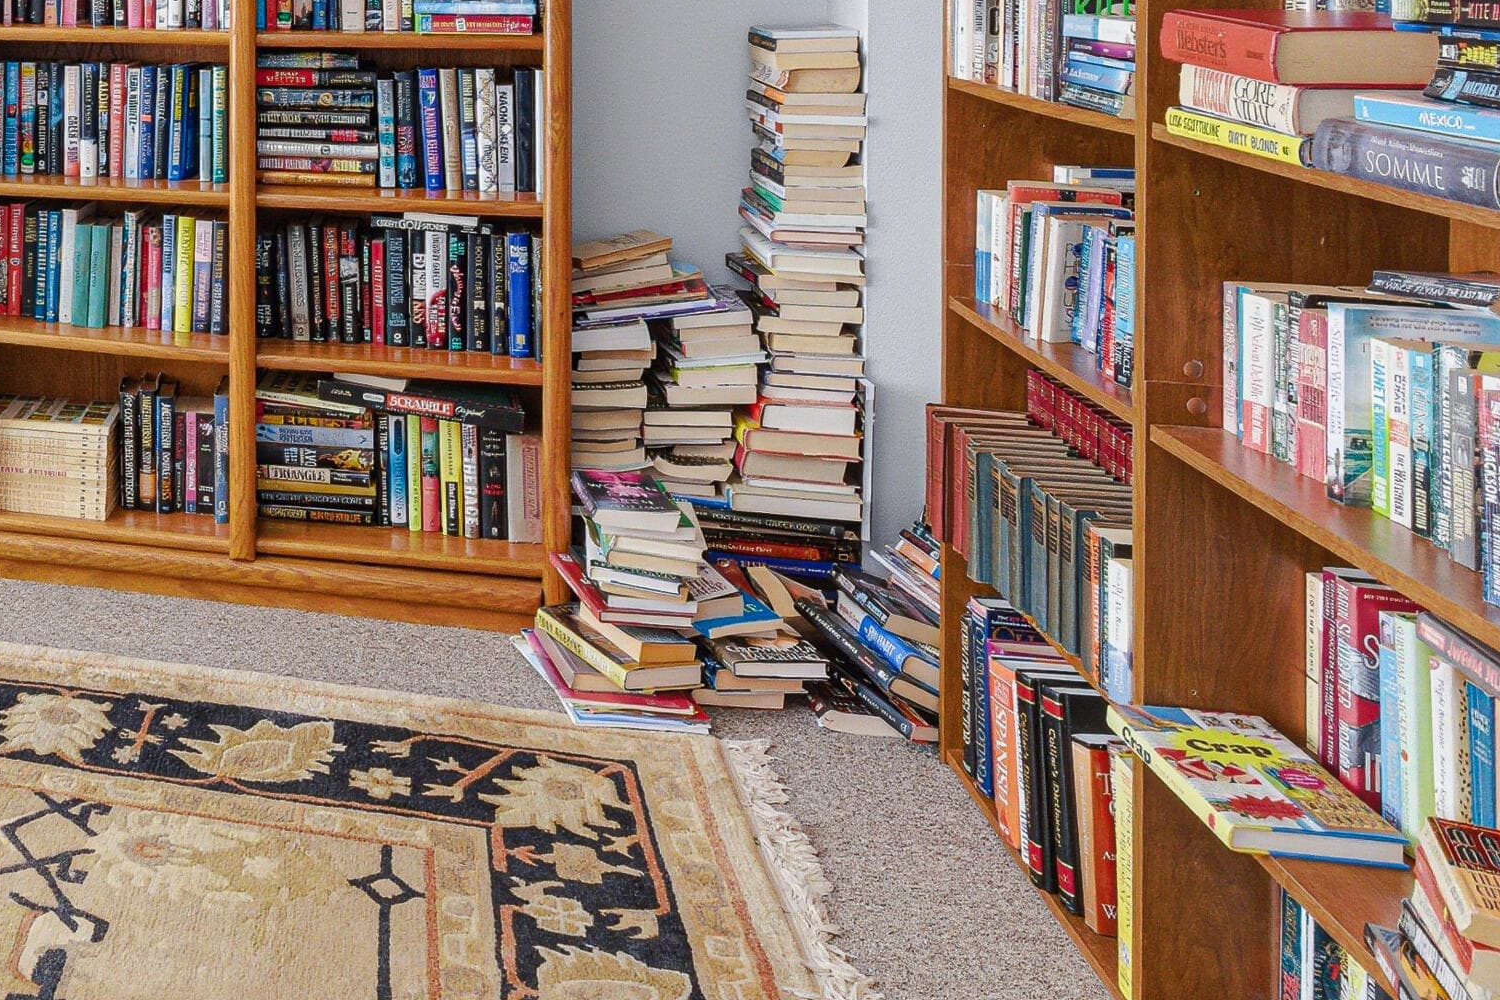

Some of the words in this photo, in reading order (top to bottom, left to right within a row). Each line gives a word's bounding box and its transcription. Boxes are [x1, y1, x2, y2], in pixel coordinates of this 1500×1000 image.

[1175, 28, 1227, 58] Webster's
[1234, 78, 1277, 107] GORE
[1234, 98, 1277, 129] VIDAL
[1419, 111, 1463, 130] MEXICO
[1169, 114, 1183, 129] LISA
[1183, 116, 1220, 138] SCOTTOLINE
[1228, 130, 1248, 148] DIRTY
[1251, 134, 1279, 156] BLONDE
[1365, 150, 1445, 191] SOMME
[1330, 327, 1343, 368] Silent
[1330, 371, 1342, 402] Wife
[1373, 360, 1385, 398] JANET
[1484, 448, 1497, 504] JACKSON
[1337, 585, 1349, 620] KARIN
[974, 626, 986, 700] CHAPMAN
[1338, 622, 1351, 709] SLAUGHTER
[994, 709, 1009, 802] SPANISH
[1020, 711, 1030, 759] Collier's
[1048, 728, 1060, 778] Collier's
[1121, 725, 1152, 765] Crap
[1186, 737, 1274, 759] Crap
[1052, 783, 1063, 849] Dictionary
